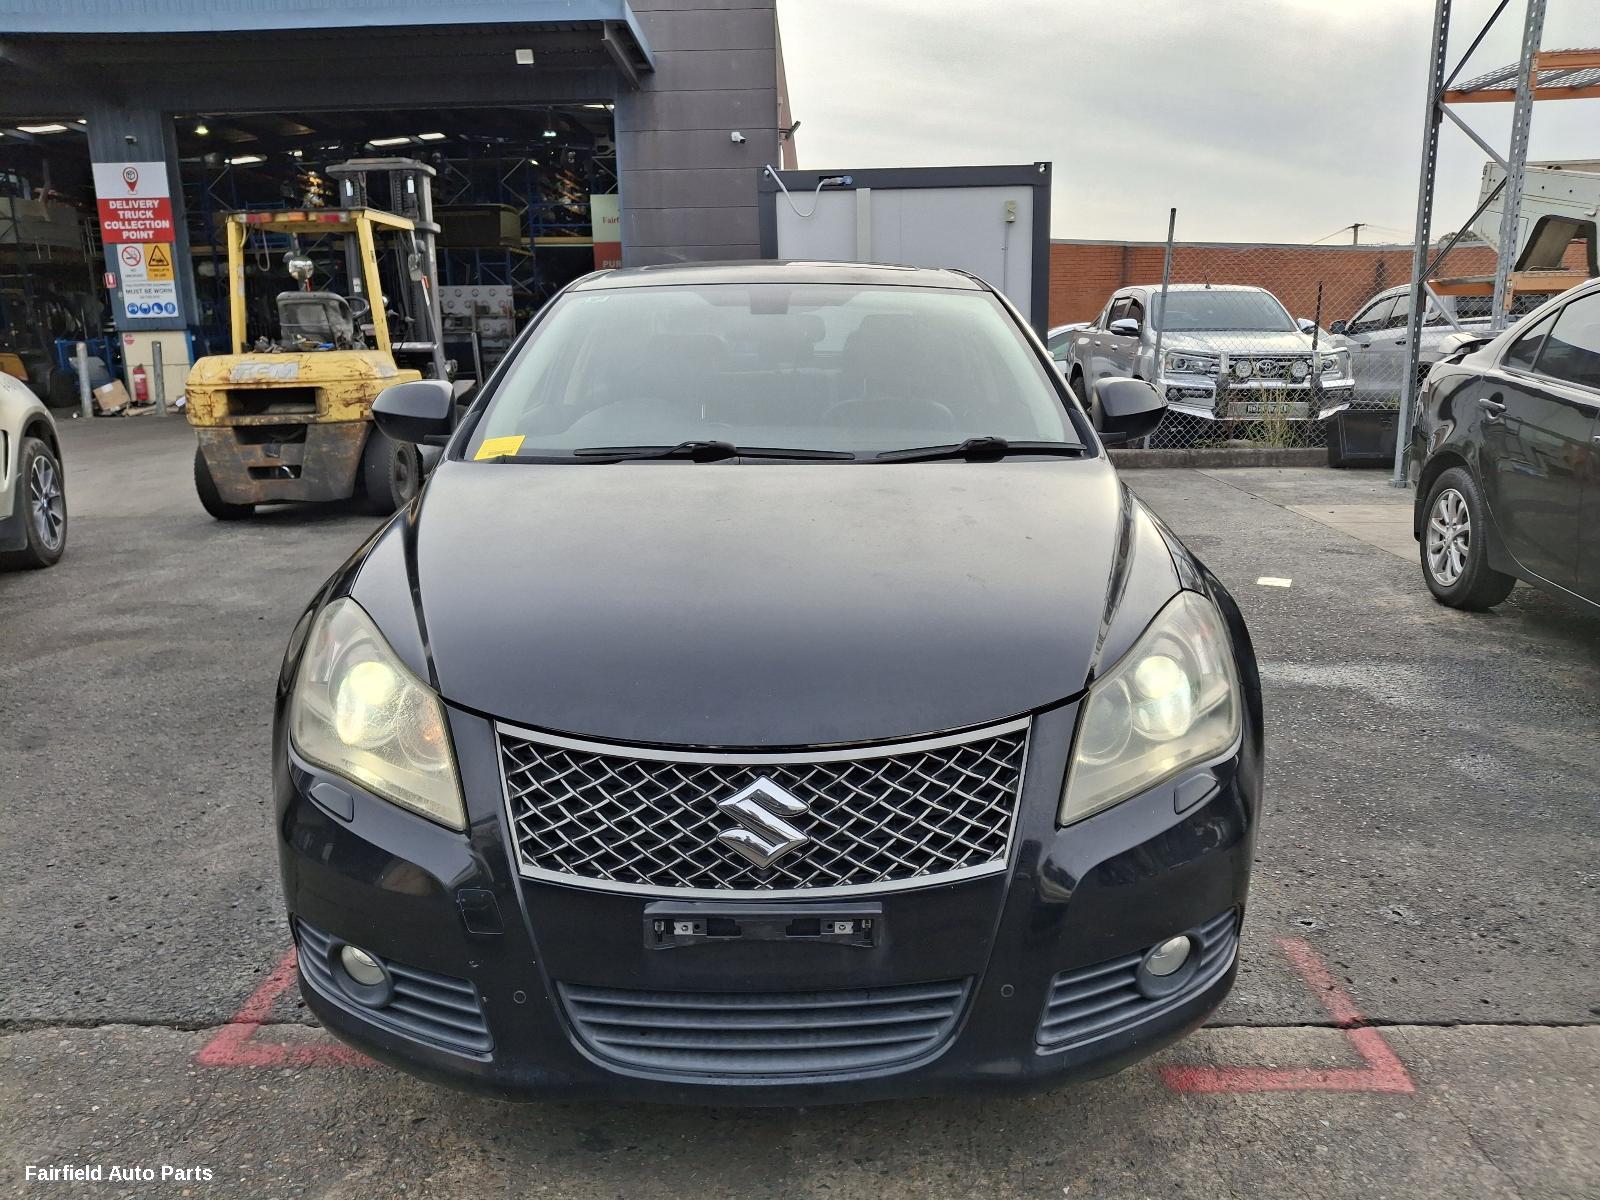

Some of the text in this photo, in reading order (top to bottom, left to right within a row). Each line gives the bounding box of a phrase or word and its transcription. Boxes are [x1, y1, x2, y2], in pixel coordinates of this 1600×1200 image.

[109, 200, 159, 209] DELIVERY
[117, 210, 154, 219] TRUCK
[104, 220, 170, 229] COLLECTION
[122, 230, 154, 239] POINT
